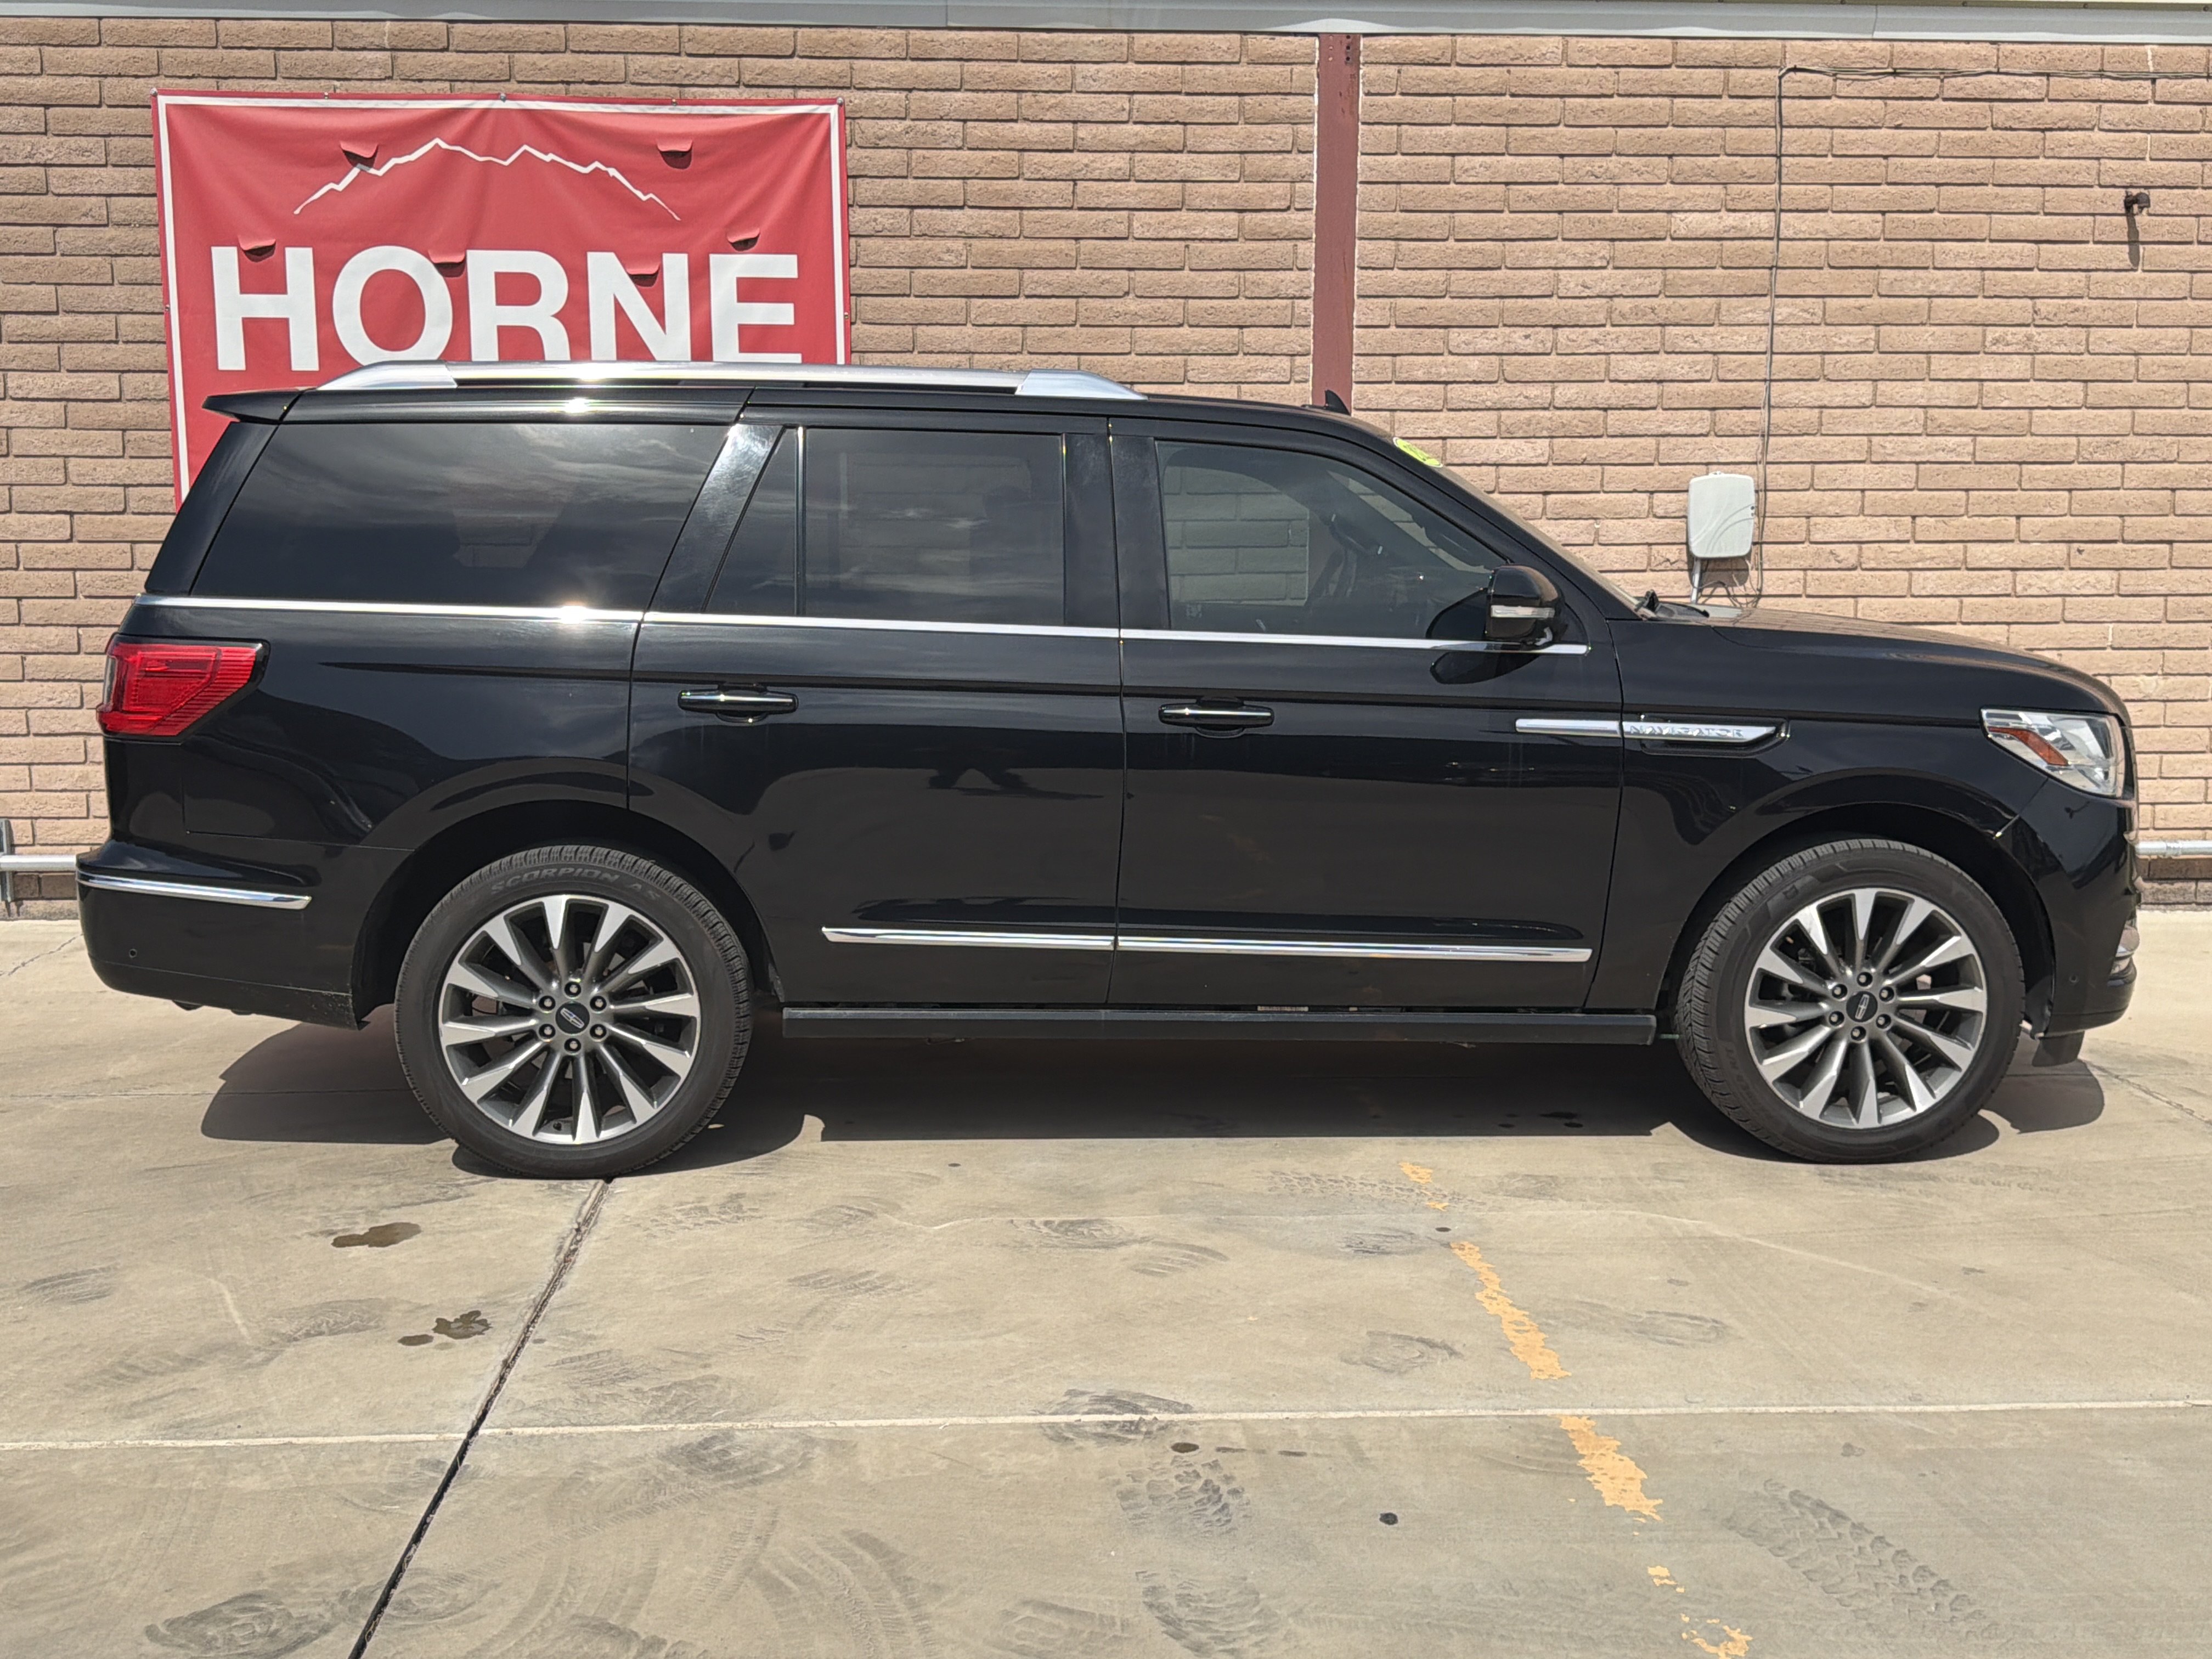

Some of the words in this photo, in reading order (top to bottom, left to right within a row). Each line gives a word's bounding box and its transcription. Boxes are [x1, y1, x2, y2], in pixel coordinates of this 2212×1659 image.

[211, 245, 802, 371] HORNE
[1630, 725, 1743, 738] NAVIGATOR
[490, 867, 620, 895] SCORPION
